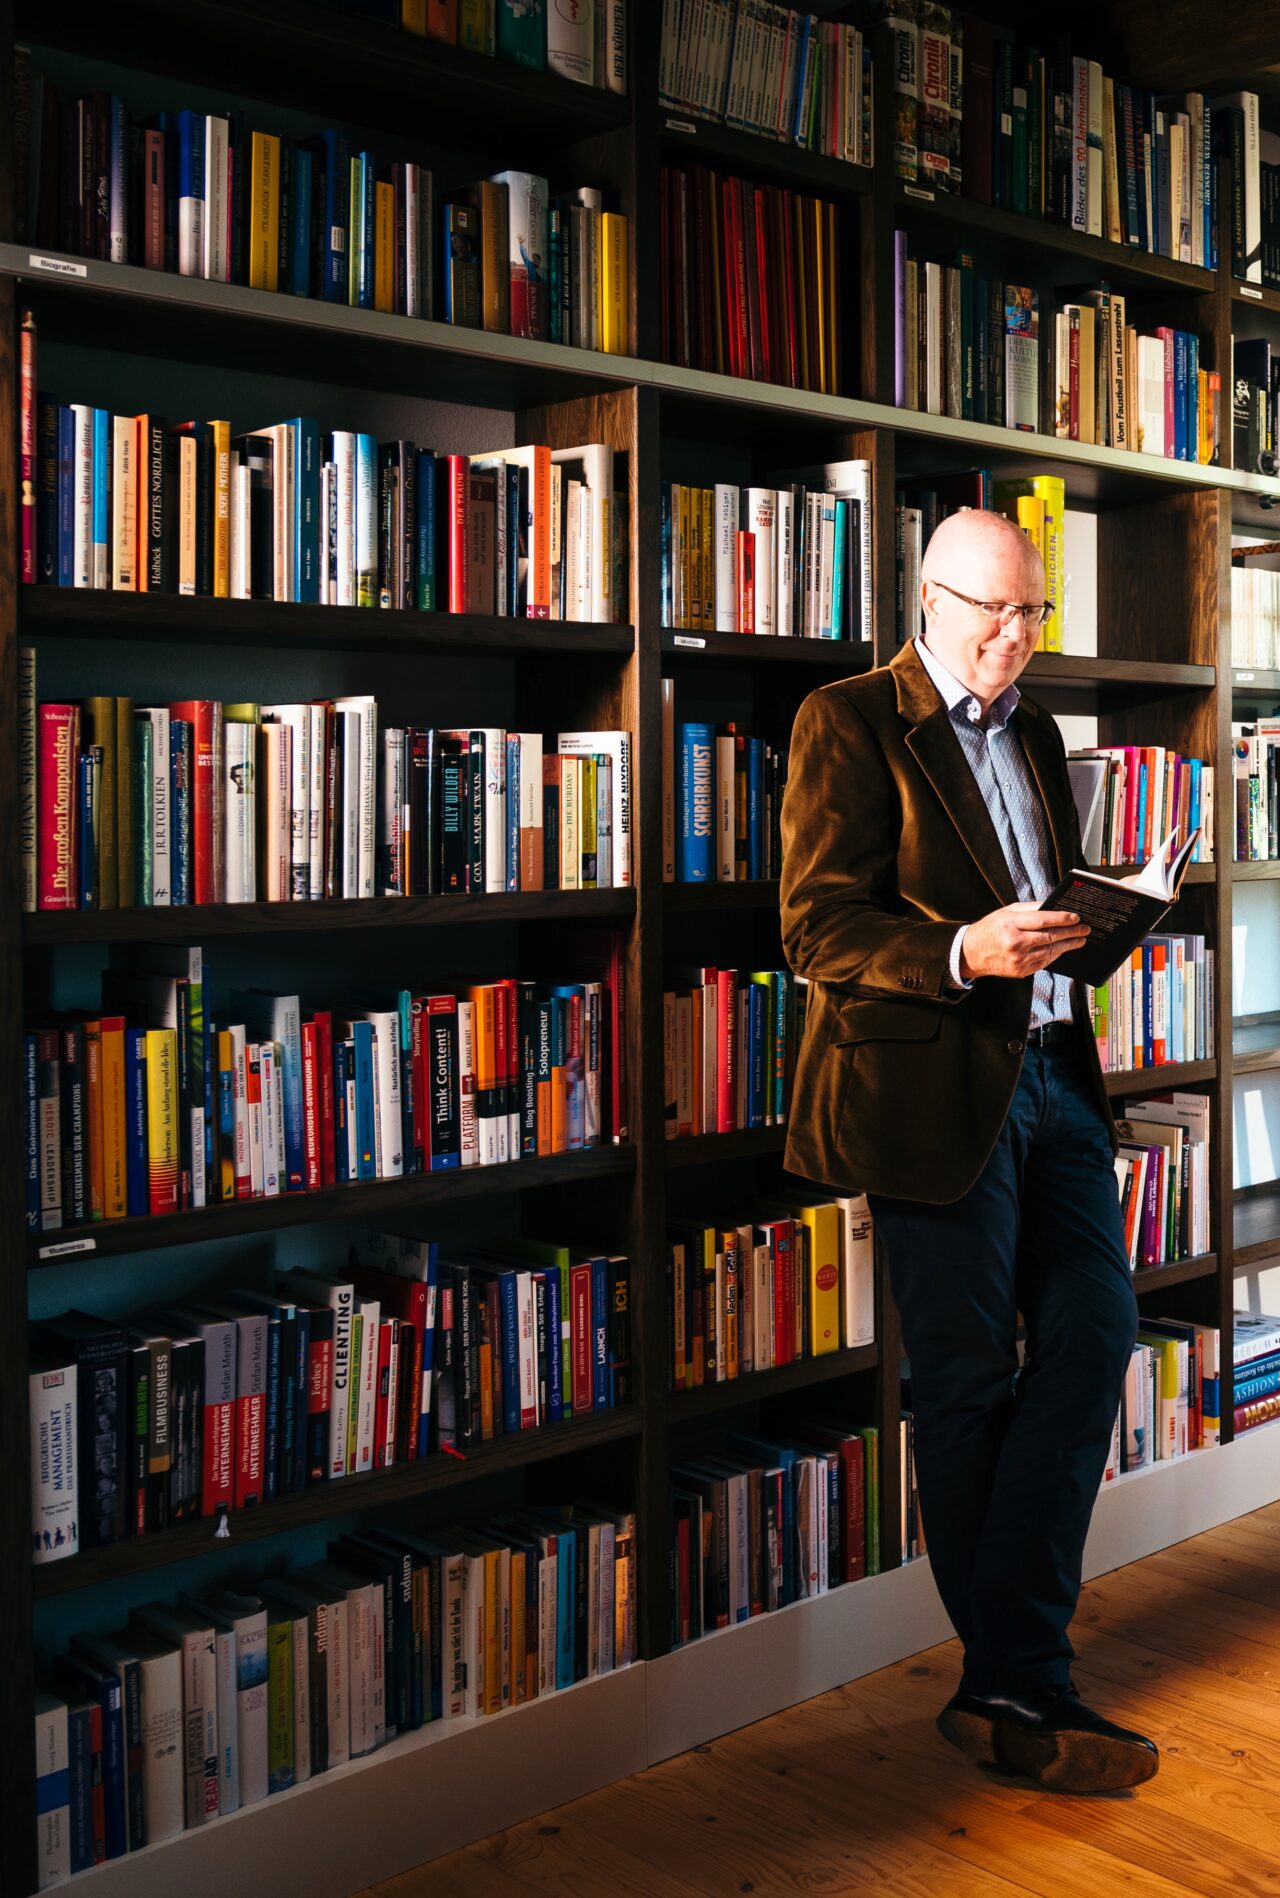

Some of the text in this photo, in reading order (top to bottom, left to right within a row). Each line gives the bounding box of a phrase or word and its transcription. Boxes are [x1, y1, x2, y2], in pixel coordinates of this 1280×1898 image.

[611, 5, 624, 78] DER KÖRPER
[896, 30, 910, 84] Chronik
[924, 37, 941, 99] Chronik
[940, 42, 948, 81] Deutschen
[949, 54, 959, 110] Die Chronik
[1074, 65, 1087, 225] Bilder des 20 Jahrhunderts
[261, 138, 271, 232] STRAHLENDE HERRLICHKEIT
[40, 259, 77, 273] Biografie
[1114, 303, 1125, 443] Vom Faustkeil zum Laserstrahl
[219, 452, 228, 488] MOTHERS
[382, 469, 390, 531] Thomas Merton
[456, 473, 464, 524] DER TRAUM
[151, 428, 162, 584] Holböck GOTTES NORDLICHT
[219, 490, 228, 518] DESERT
[20, 657, 34, 857] JOHANN SEBASTIAN BACH
[621, 740, 629, 833] HEINZ NIXDORF
[54, 726, 73, 888] Die großen Komponisten
[445, 768, 458, 832] BILLY WILDER
[693, 744, 712, 836] SCHREIBKUNST
[474, 773, 482, 882] COX MARK TWAIN
[66, 1033, 76, 1063] campus
[390, 1018, 398, 1043] Erfolg!
[412, 1018, 421, 1057] Storytelling
[538, 1010, 550, 1075] Solopreneur
[391, 1061, 399, 1090] Natürlich
[436, 1028, 448, 1124] Think Content!
[525, 1072, 535, 1128] Blog Boosting
[28, 1044, 37, 1179] Das Geheimnis der Marke
[304, 1059, 316, 1184] Hager NEUKUNDEN-GEWINNUNG
[462, 1100, 474, 1149] PLATFORM
[46, 1104, 56, 1202] HEROIC LEADERSHIP
[73, 1083, 83, 1218] DAS GEHEIMNIS DER CHAMPIONS
[194, 1116, 203, 1189] DEN WANDEL MANAGEN
[48, 1242, 86, 1254] Business
[537, 1285, 545, 1306] Erfolg!
[614, 1280, 627, 1312] ICH
[221, 1334, 232, 1400] Stefan Merath
[252, 1326, 262, 1392] Stefan Merath
[335, 1292, 350, 1389] CLIENTING
[508, 1331, 516, 1363] PRINZIP
[597, 1327, 606, 1364] LAUNCH
[156, 1354, 167, 1443] FILMBUSINESS
[311, 1364, 321, 1395] Forbes
[1234, 1376, 1275, 1403] ASHION
[64, 1402, 73, 1472] PRAXISHANDBUCH
[212, 1407, 220, 1443] erfolgreichen
[220, 1405, 231, 1488] UNTERNEHMER
[242, 1398, 250, 1435] erfolgreichen
[250, 1397, 260, 1479] UNTERNEHMER
[40, 1421, 49, 1484] ERFOLGREICHES
[51, 1409, 63, 1491] MANAGEMENT
[212, 1457, 220, 1469] Weg
[242, 1449, 250, 1461] Weg
[400, 1554, 412, 1602] campus
[314, 1604, 328, 1653] campus
[334, 1655, 340, 1663] ZU
[205, 1756, 217, 1812] DEAD AID
